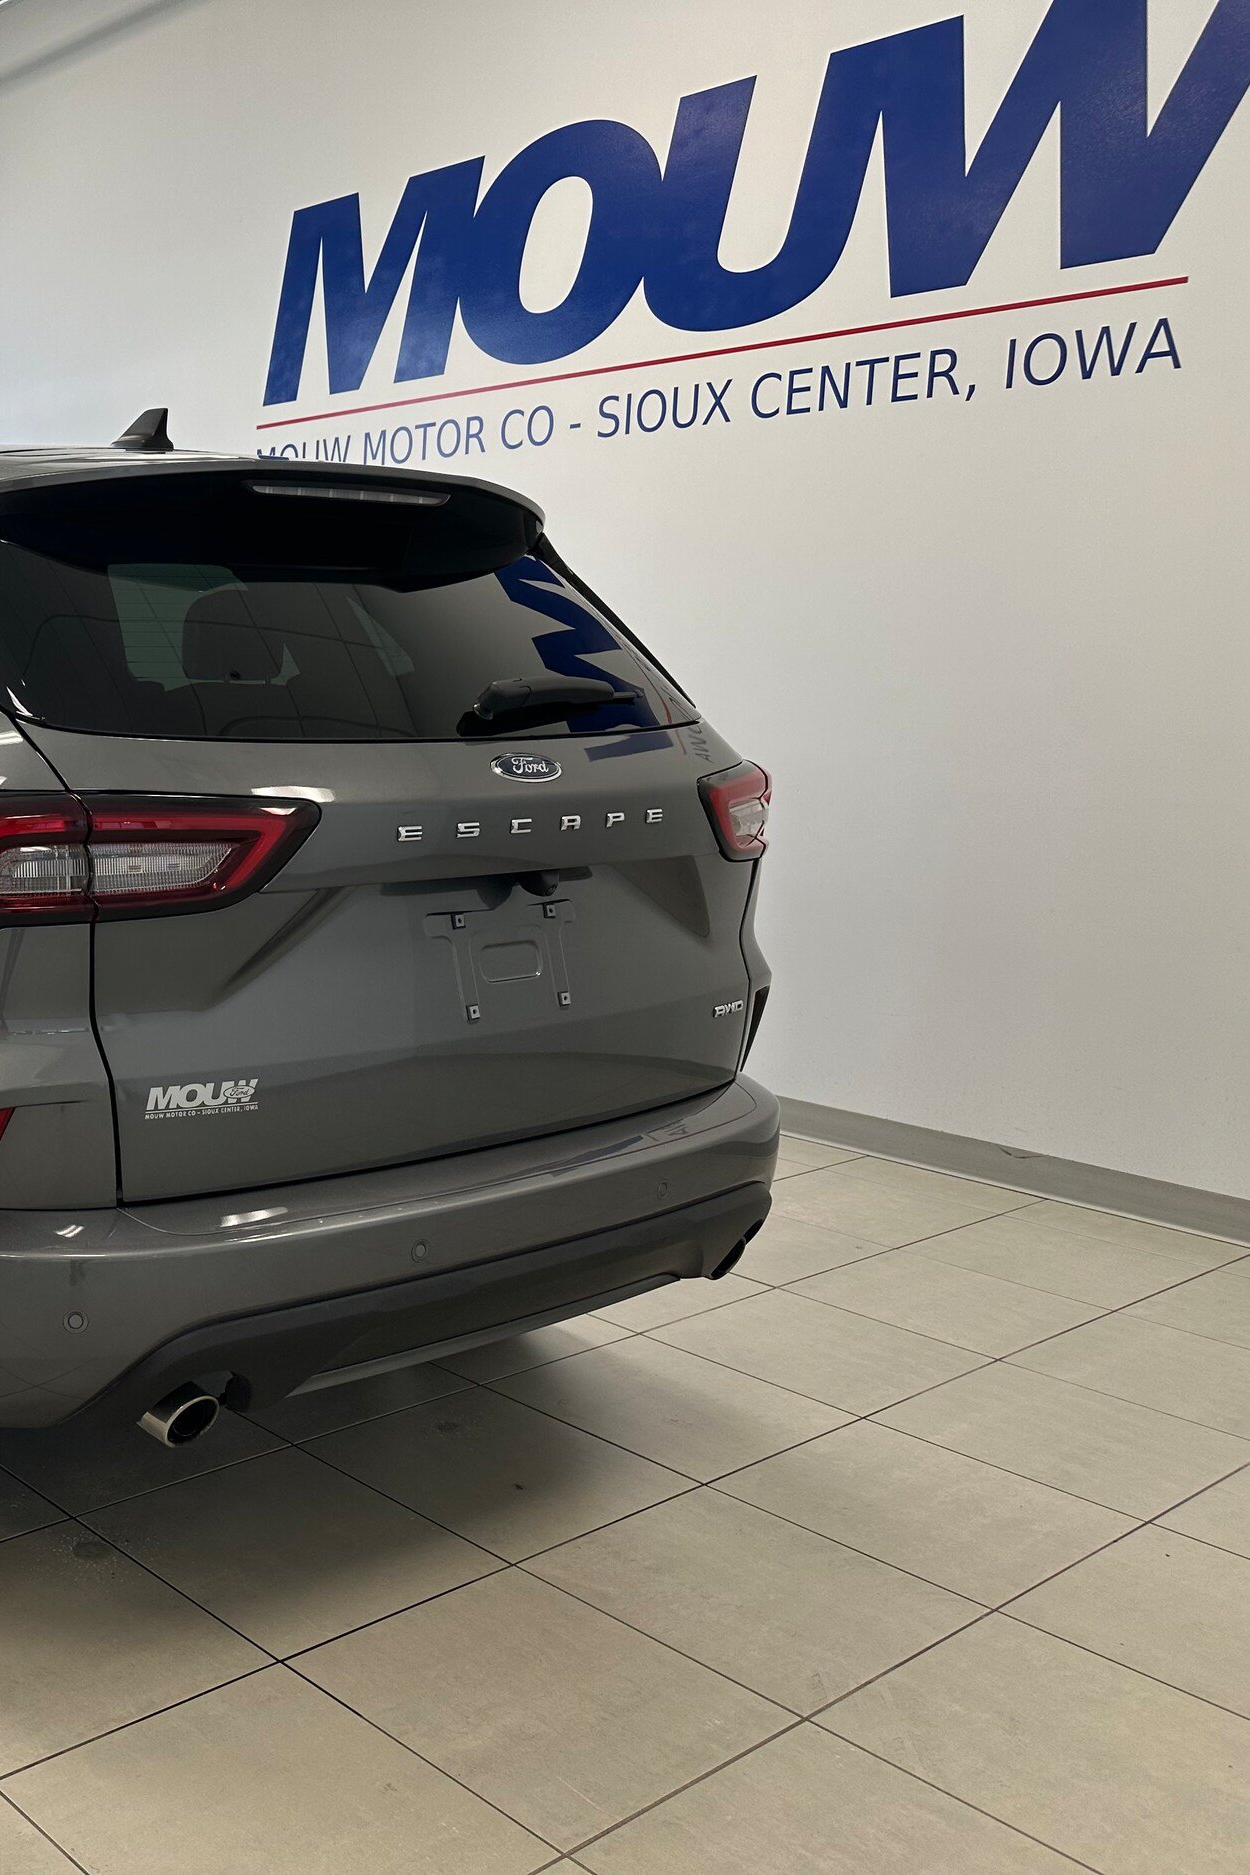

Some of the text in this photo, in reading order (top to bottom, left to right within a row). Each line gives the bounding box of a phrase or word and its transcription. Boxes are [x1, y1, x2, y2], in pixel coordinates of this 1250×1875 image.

[263, 0, 1250, 406] MOUW
[363, 415, 486, 465] MOTOR
[500, 405, 554, 450] CO
[597, 378, 733, 438] SIOUX
[751, 348, 976, 419] CENTER,
[1005, 317, 1182, 389] IOWA
[398, 808, 663, 842] ESCAPE
[713, 999, 744, 1018] AWD
